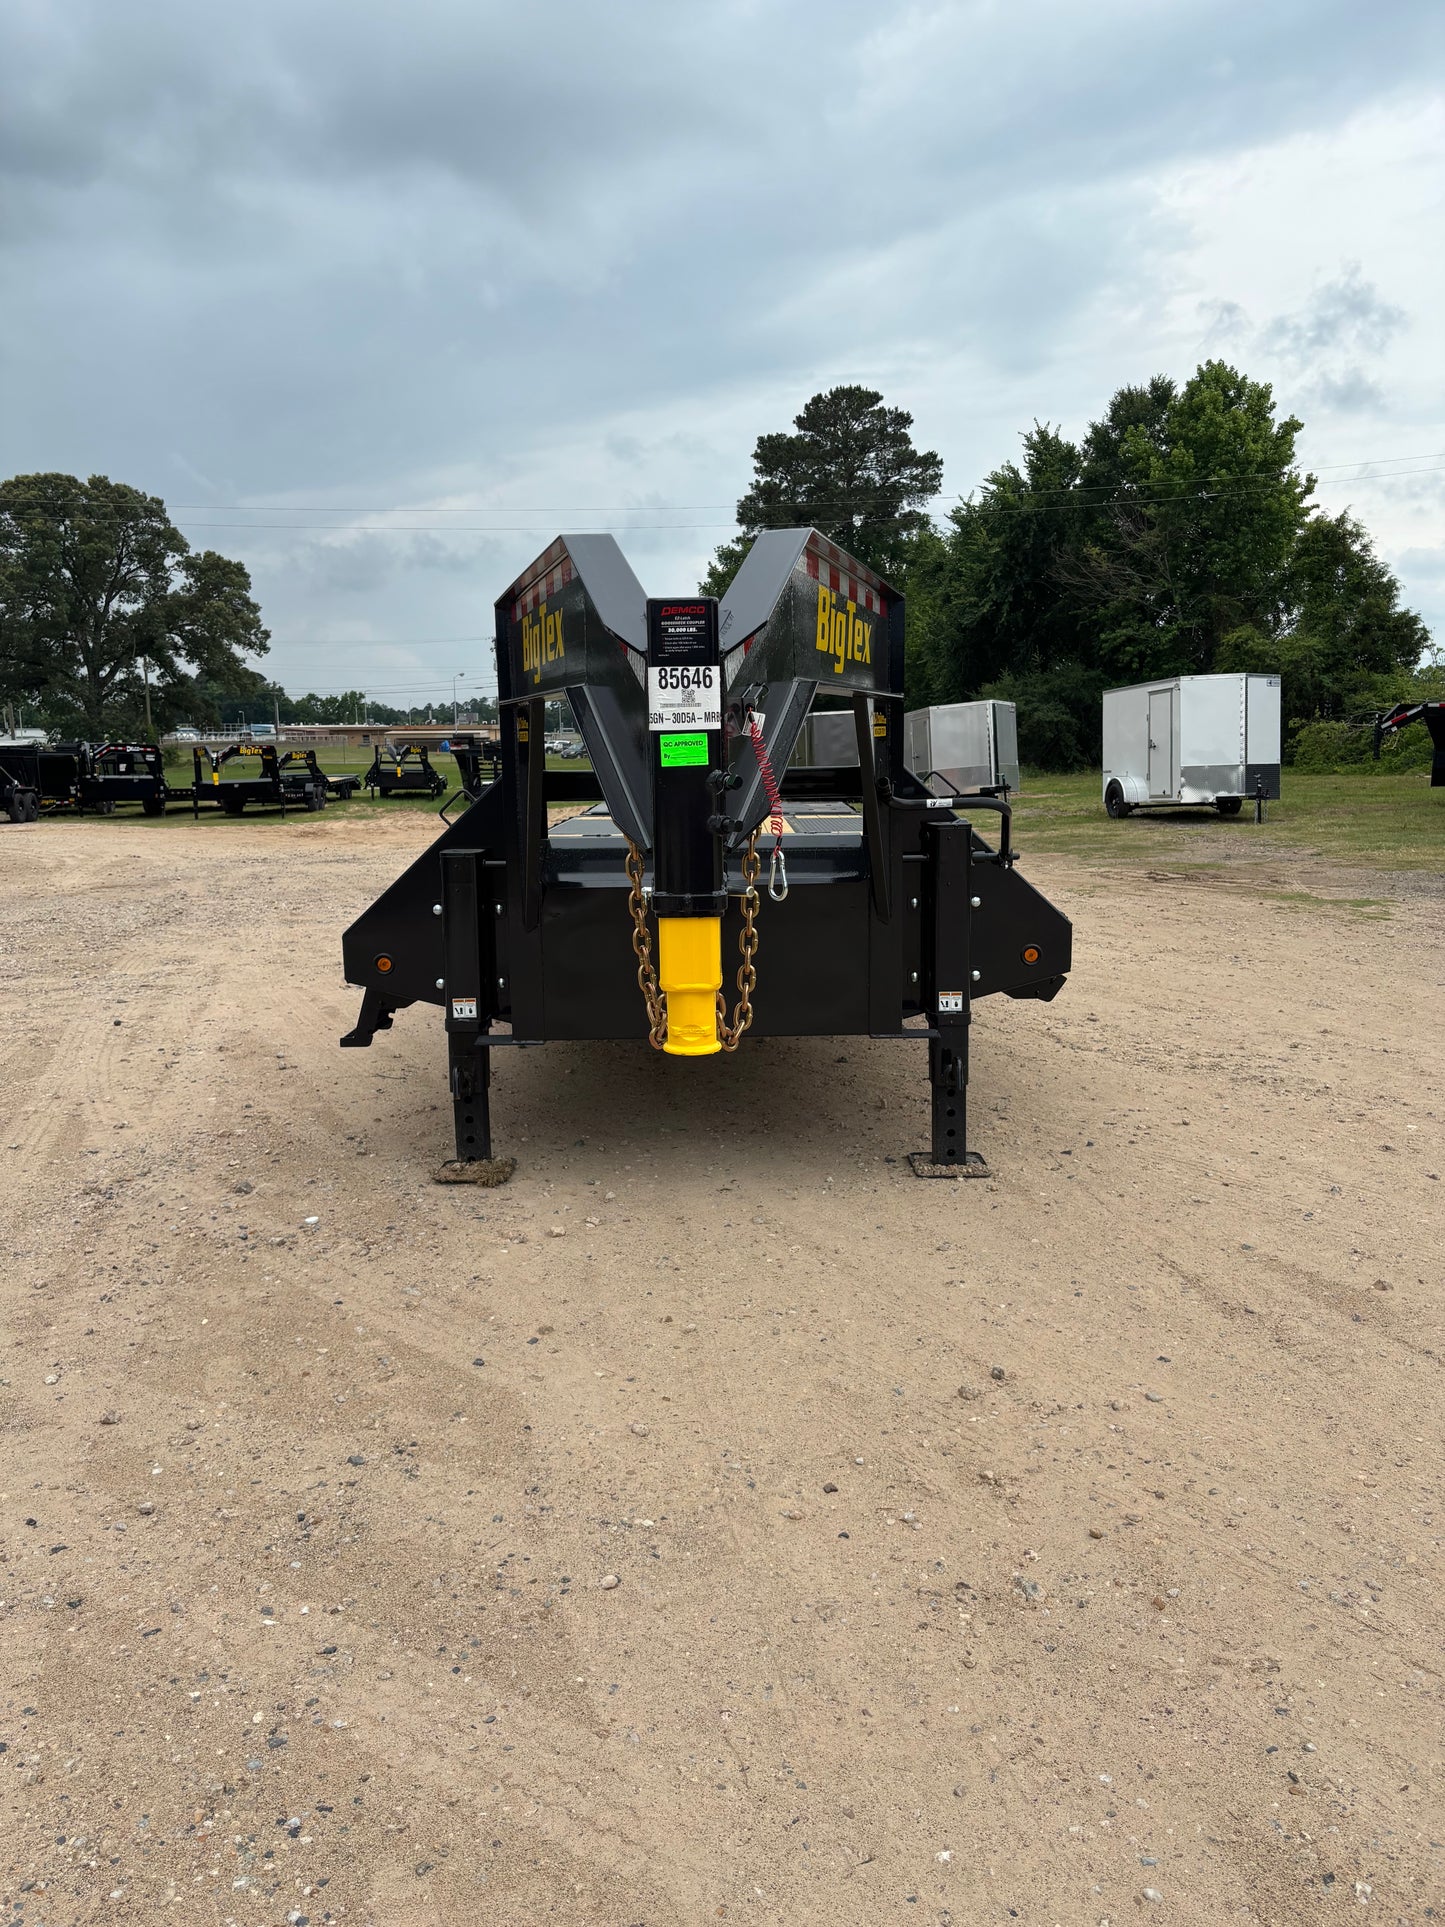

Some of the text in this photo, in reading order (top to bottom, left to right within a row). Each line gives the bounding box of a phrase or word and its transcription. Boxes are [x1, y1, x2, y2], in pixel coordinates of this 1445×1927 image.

[660, 605, 705, 616] DEMCO
[816, 584, 872, 674] BigTex
[522, 602, 565, 684] BigTex
[658, 667, 713, 689] 85646
[240, 746, 263, 756] BigTex
